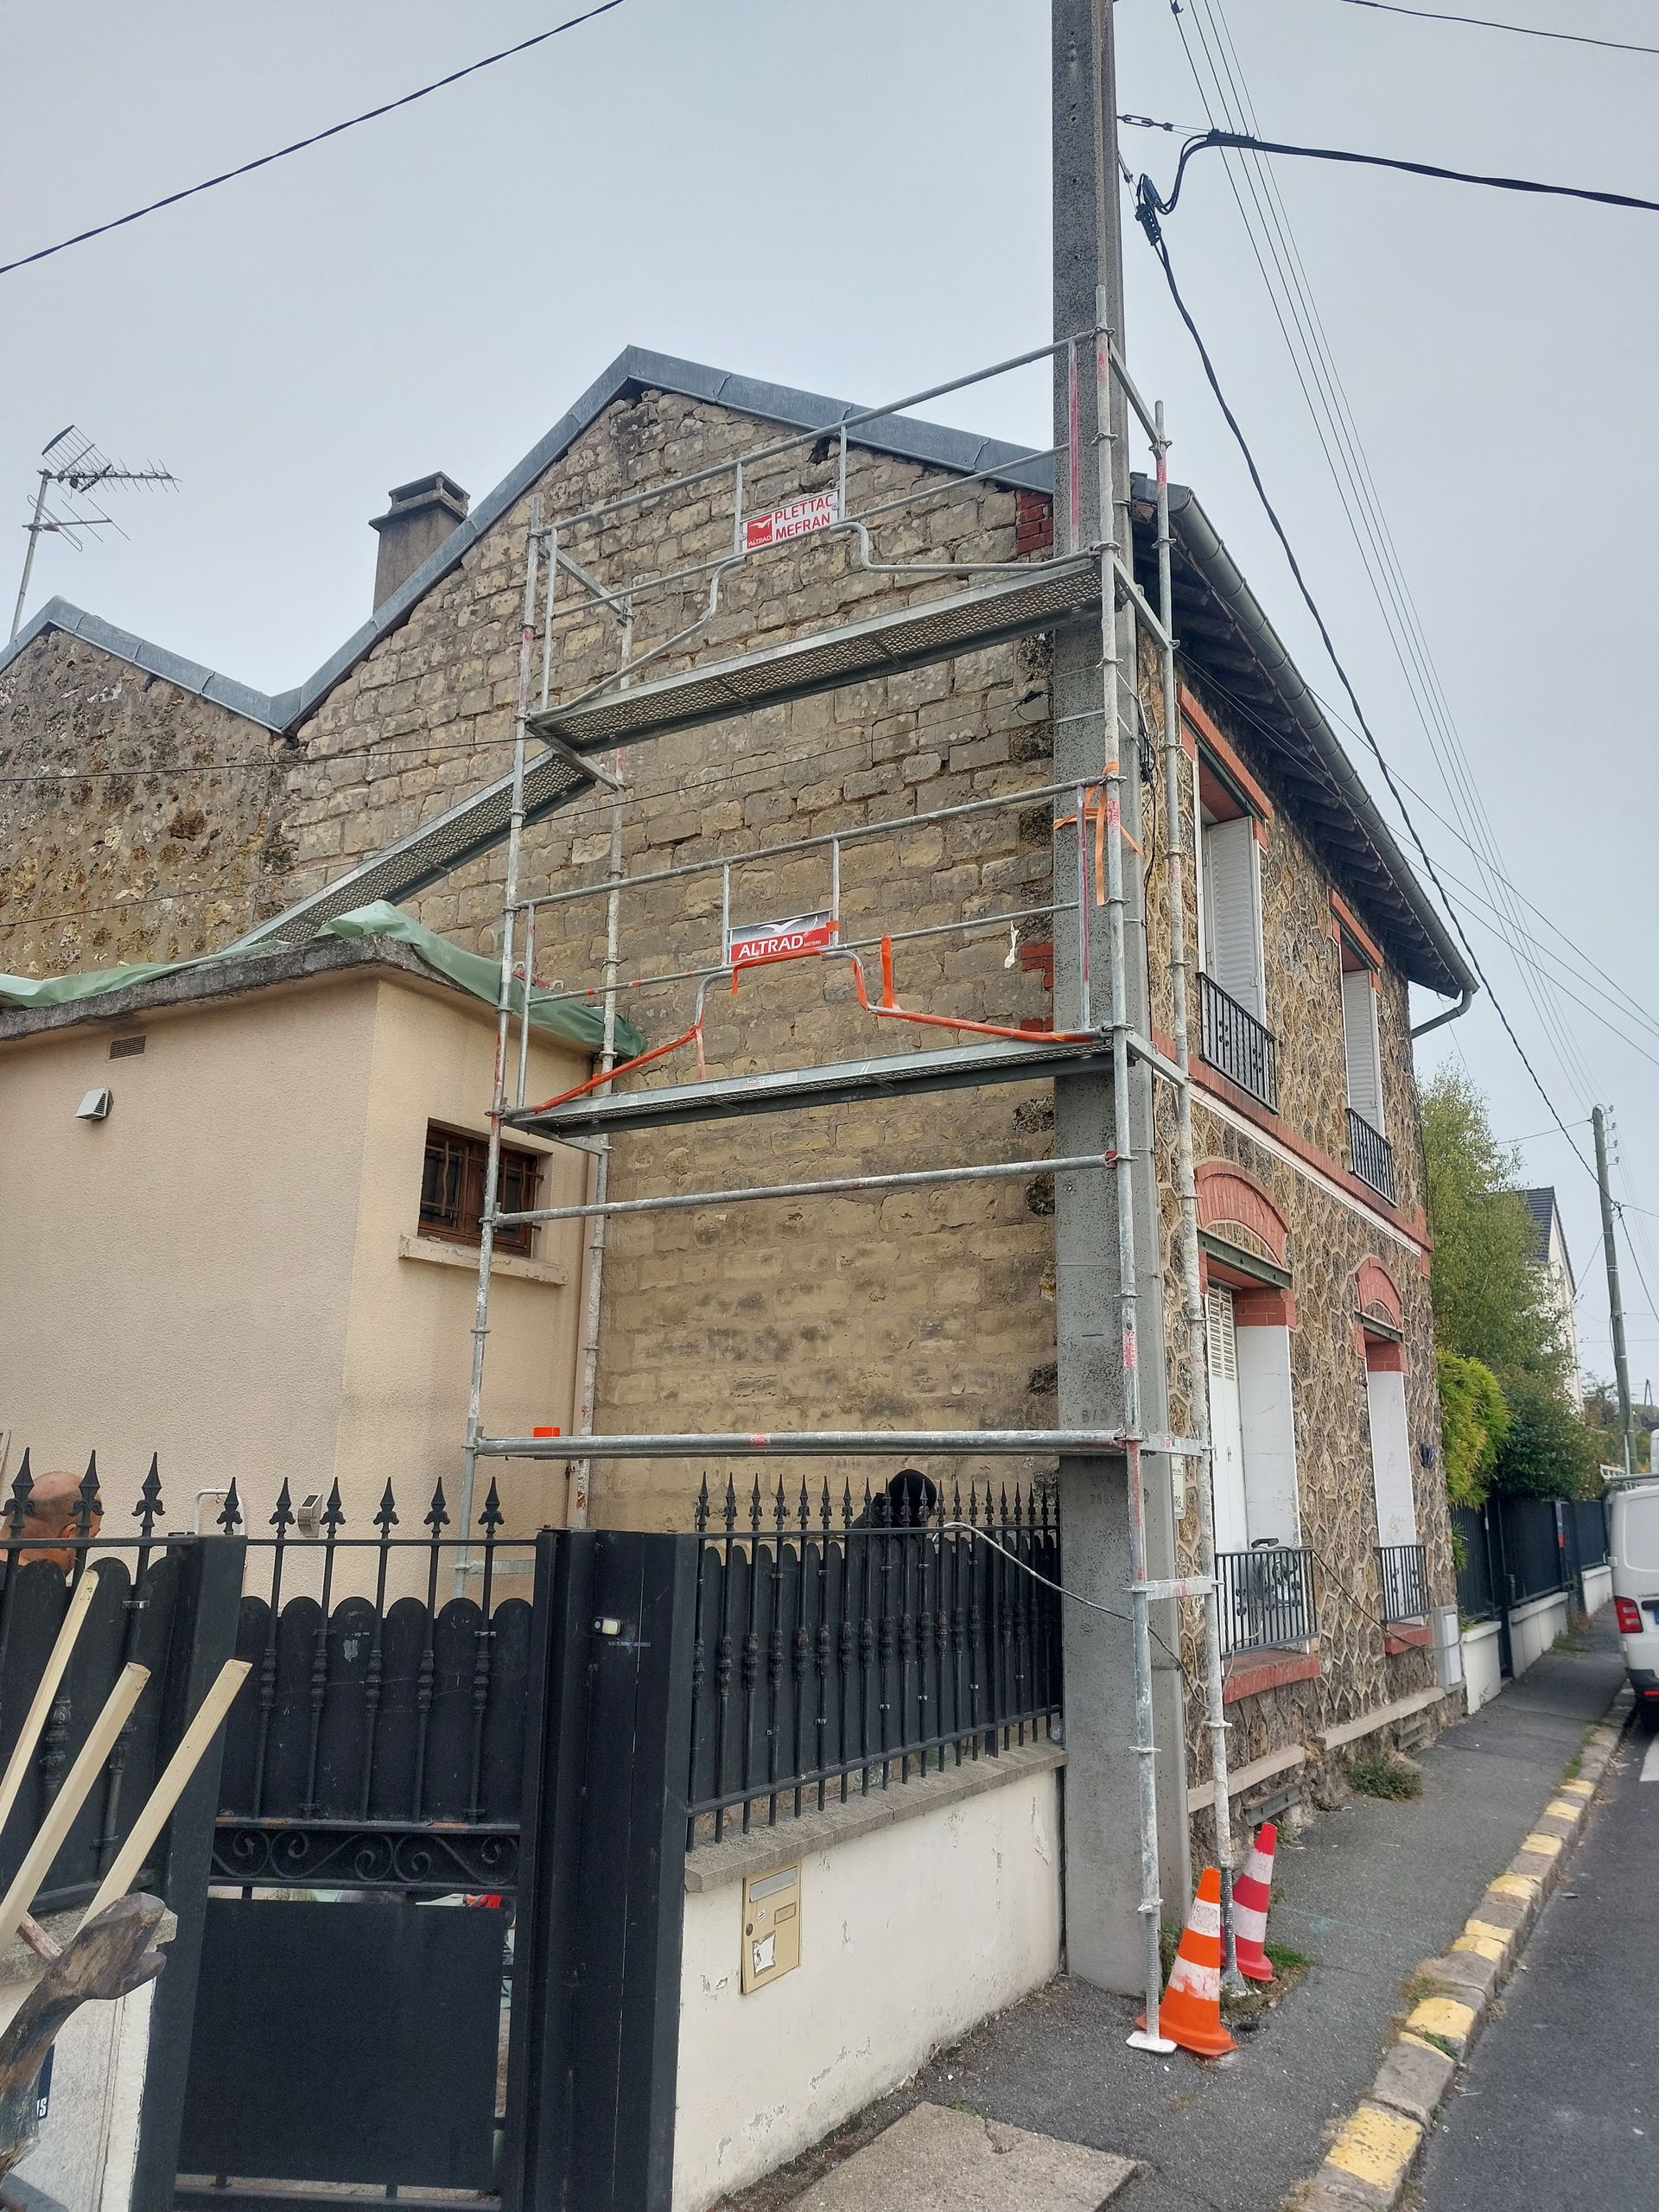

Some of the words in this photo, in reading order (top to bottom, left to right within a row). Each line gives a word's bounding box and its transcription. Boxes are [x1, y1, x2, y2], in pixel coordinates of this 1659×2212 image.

[775, 493, 834, 524] PLETTAC
[775, 512, 830, 541] MEFRAN
[747, 535, 772, 548] ALTRAD
[738, 935, 804, 958] ALTRAD
